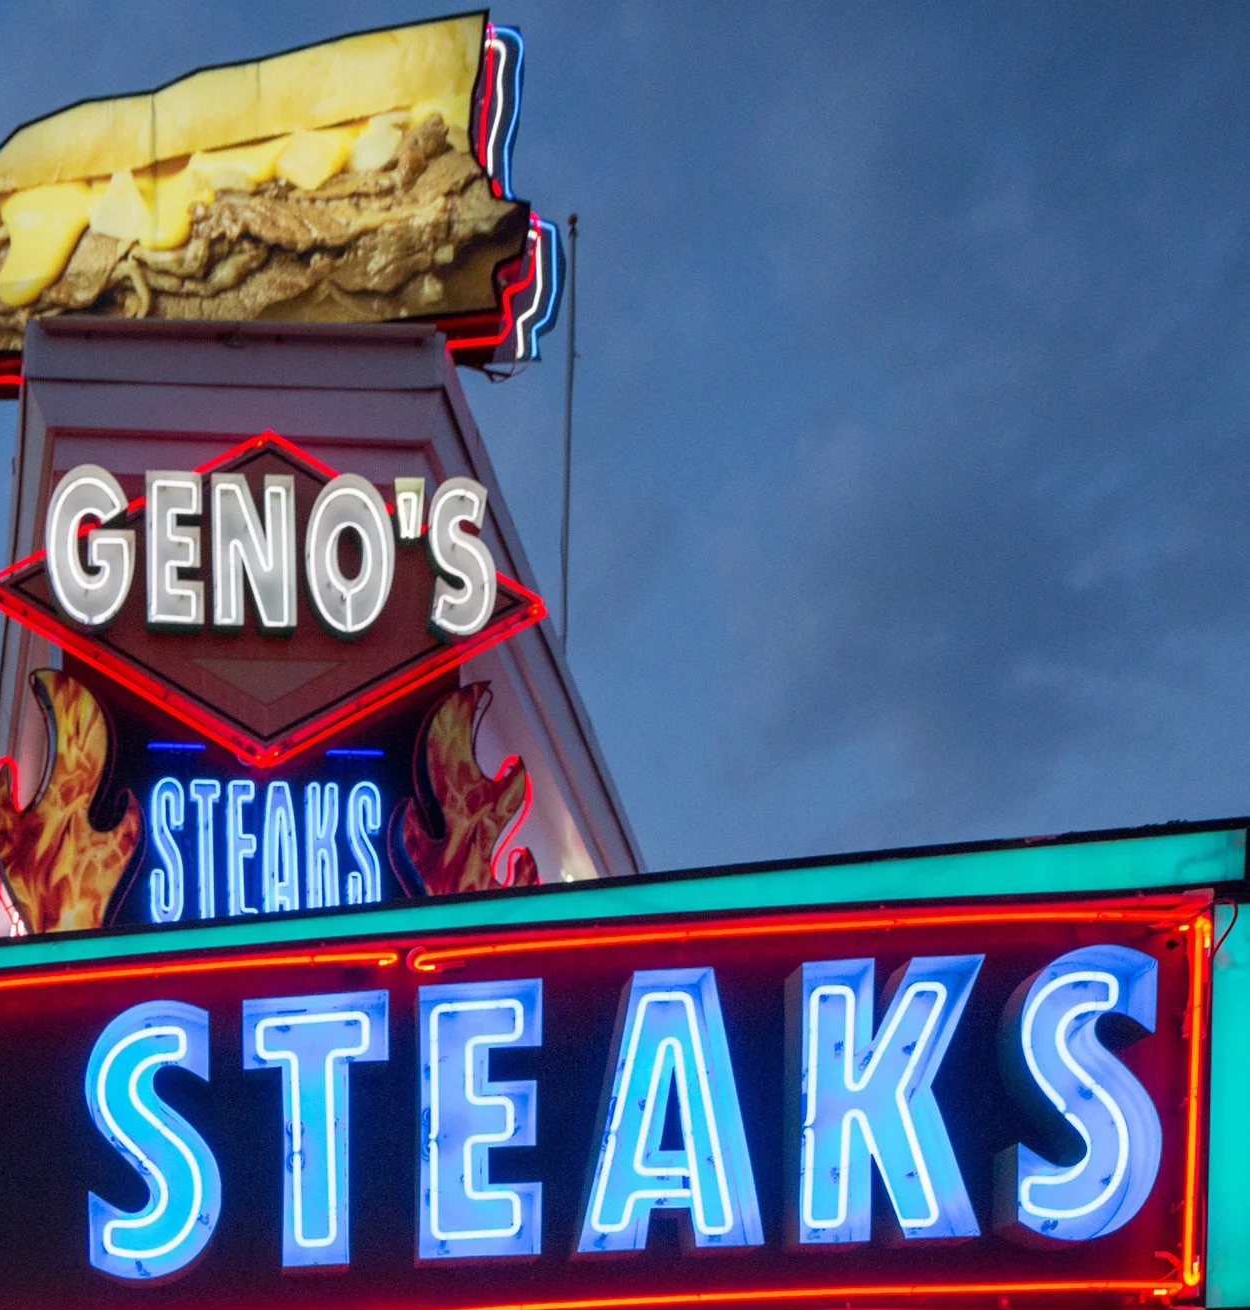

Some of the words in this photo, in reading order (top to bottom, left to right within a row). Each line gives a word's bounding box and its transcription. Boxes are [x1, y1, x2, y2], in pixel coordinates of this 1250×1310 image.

[46, 465, 497, 635] GENO'S
[150, 777, 381, 923] STEAKS
[86, 944, 1162, 1280] STEAKS
